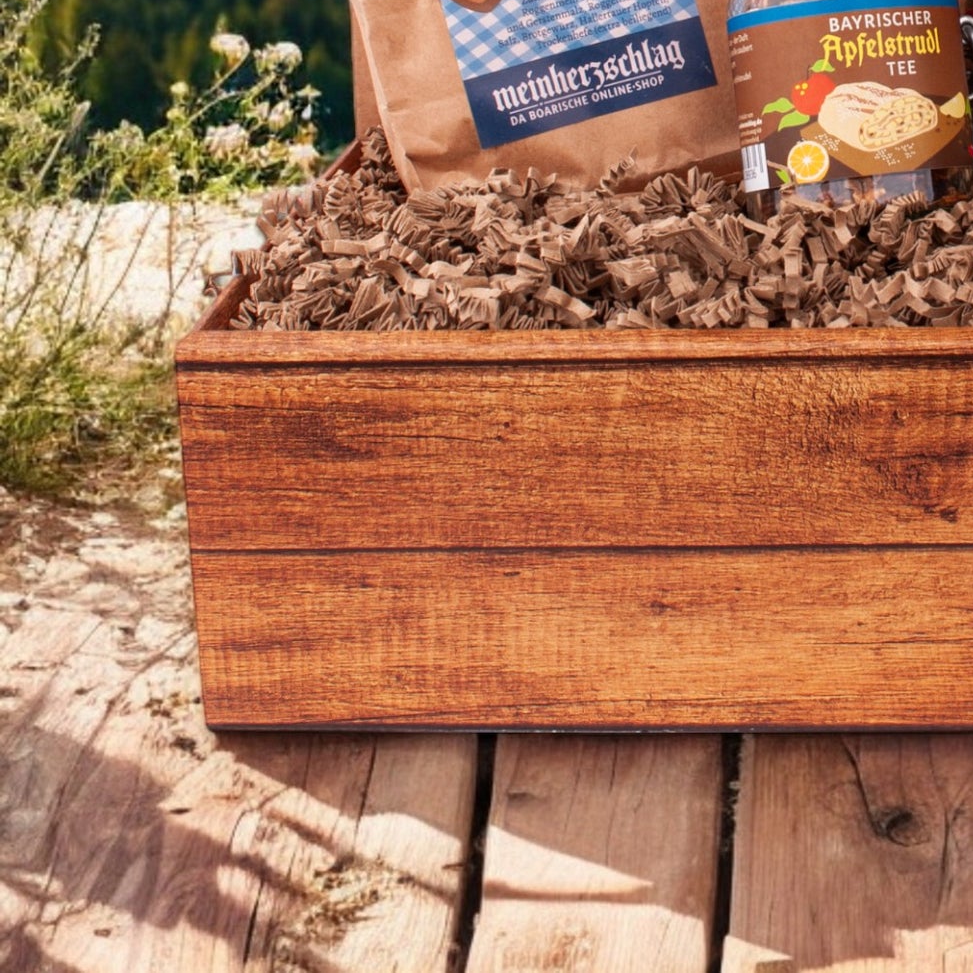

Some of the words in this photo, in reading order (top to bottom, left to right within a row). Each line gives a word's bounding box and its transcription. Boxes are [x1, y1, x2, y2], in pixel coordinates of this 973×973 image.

[829, 10, 932, 32] BAYRISCHER
[819, 27, 941, 68] Apfelstrudl
[492, 39, 685, 111] meinherzschlag
[886, 60, 917, 76] TEE
[510, 113, 527, 127] DA
[529, 96, 589, 123] BOARISCHE
